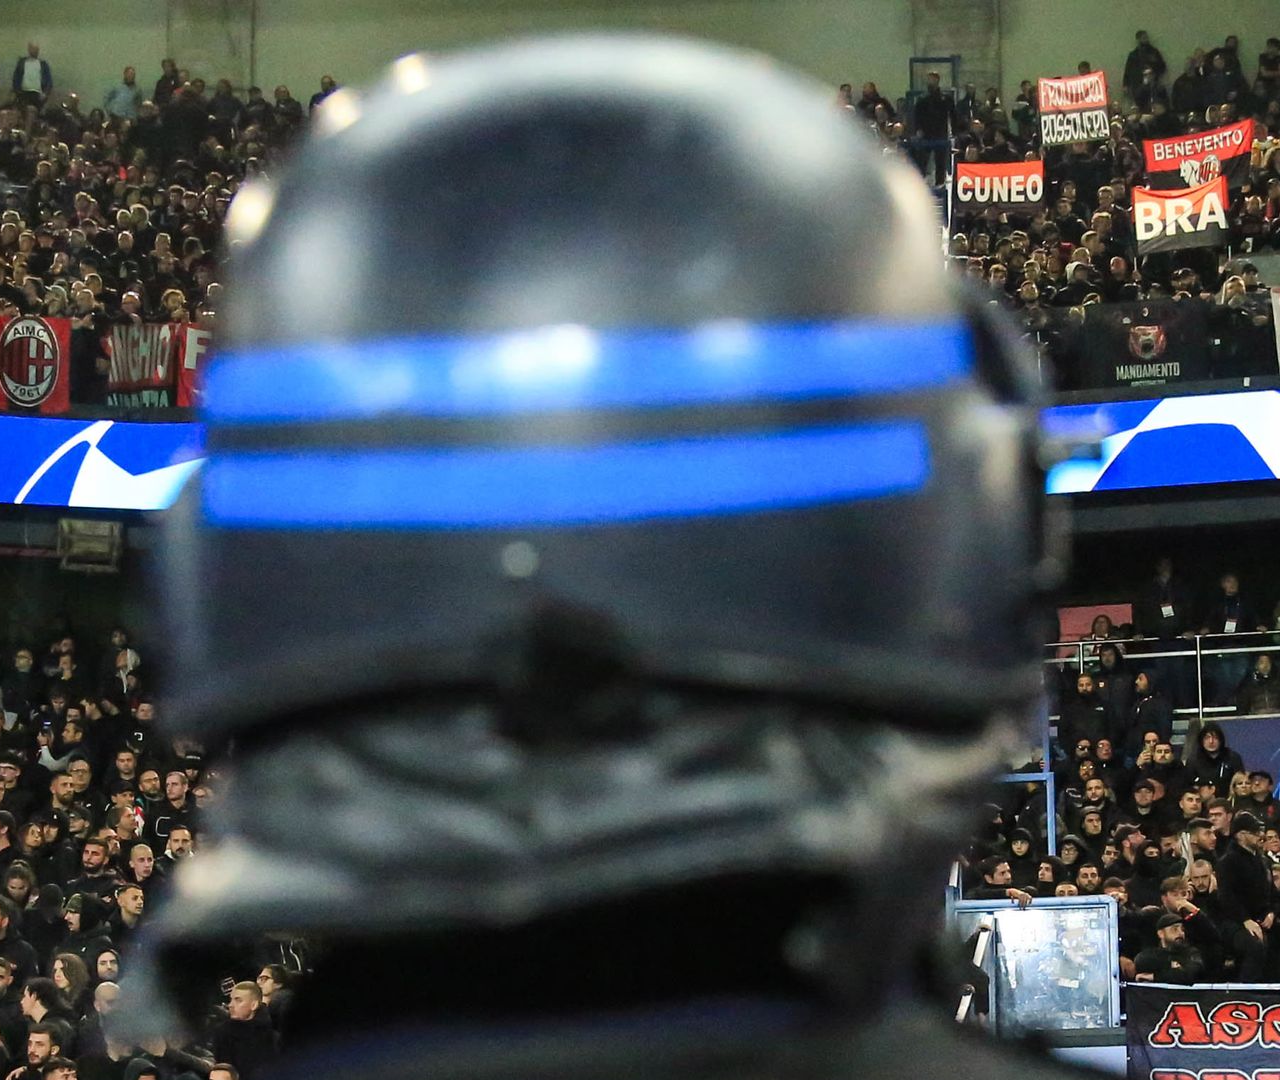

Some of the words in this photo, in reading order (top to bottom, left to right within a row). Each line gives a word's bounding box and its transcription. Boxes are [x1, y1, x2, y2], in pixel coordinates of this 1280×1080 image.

[1040, 110, 1110, 144] ROSSONERA
[1153, 129, 1244, 161] BENEVENTO
[957, 174, 1044, 202] CUNEO
[1134, 191, 1229, 241] BRA
[12, 326, 47, 339] AIMC
[1116, 362, 1180, 380] MANDAMENTO
